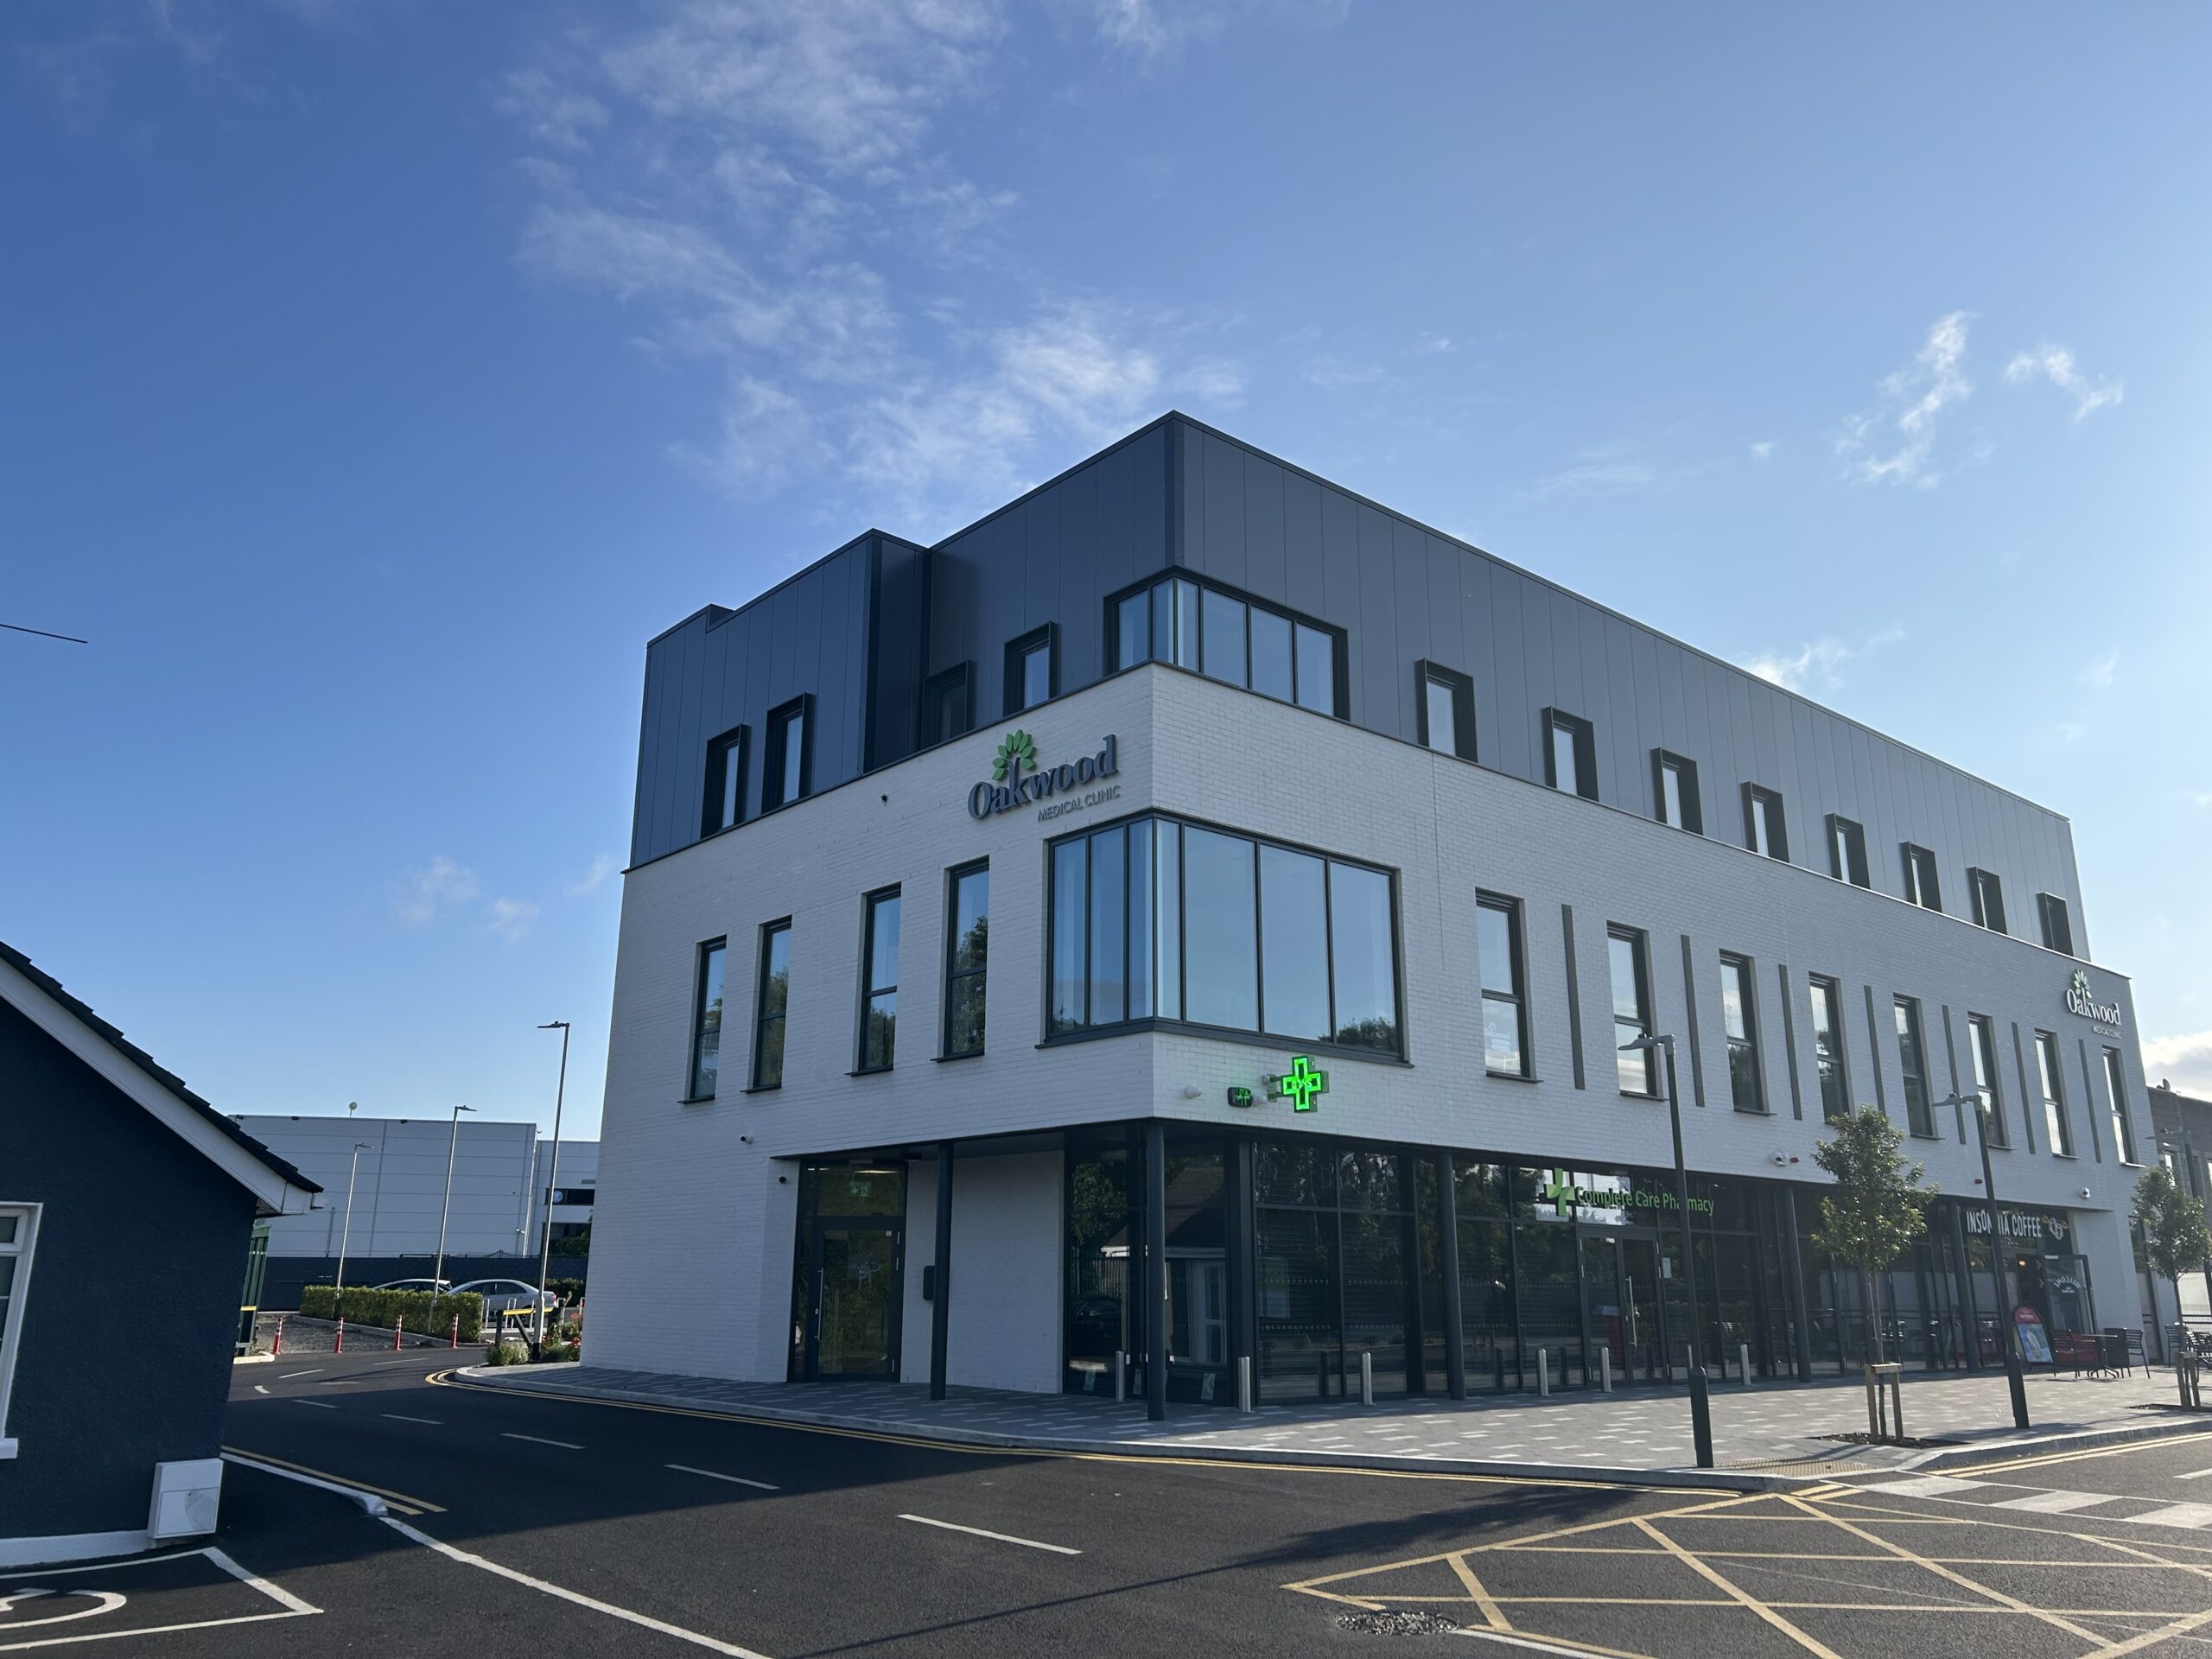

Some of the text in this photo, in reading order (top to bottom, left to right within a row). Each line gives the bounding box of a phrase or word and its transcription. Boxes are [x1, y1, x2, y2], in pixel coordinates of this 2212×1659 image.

[967, 734, 1118, 821] Oakwood
[1038, 785, 1121, 822] MEDICAL CLINIC
[2066, 987, 2122, 1026] Oakwood
[1577, 1186, 1714, 1217] Complete Care Phmacy
[1967, 1209, 2042, 1238] INSOIA COFFEE
